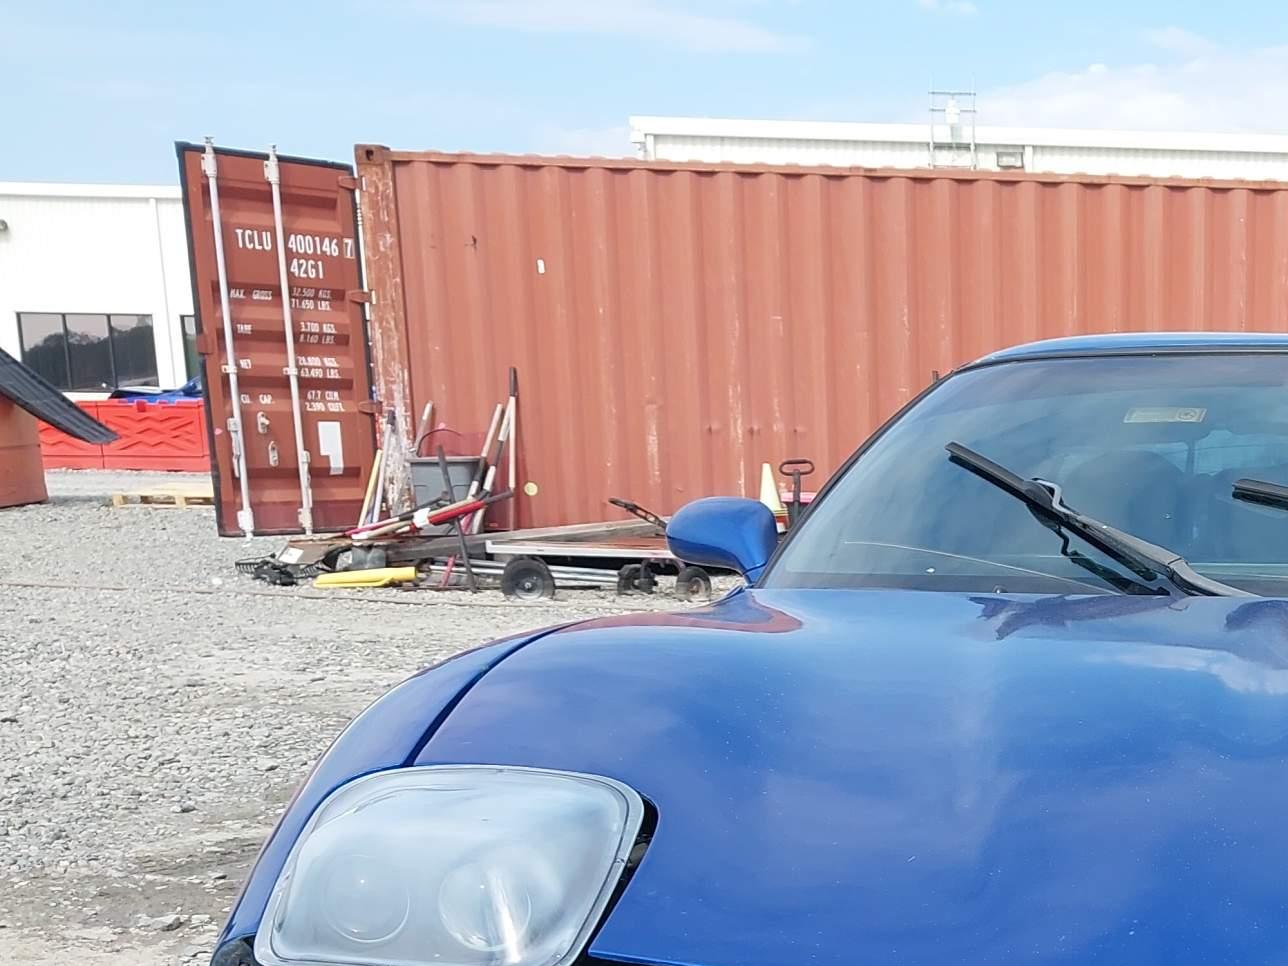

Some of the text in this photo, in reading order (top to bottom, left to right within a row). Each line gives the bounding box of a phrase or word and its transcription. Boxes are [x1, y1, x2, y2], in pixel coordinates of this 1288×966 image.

[235, 229, 355, 258] TCLU 400146 7
[290, 258, 324, 279] 42G1
[252, 289, 273, 300] GROSS
